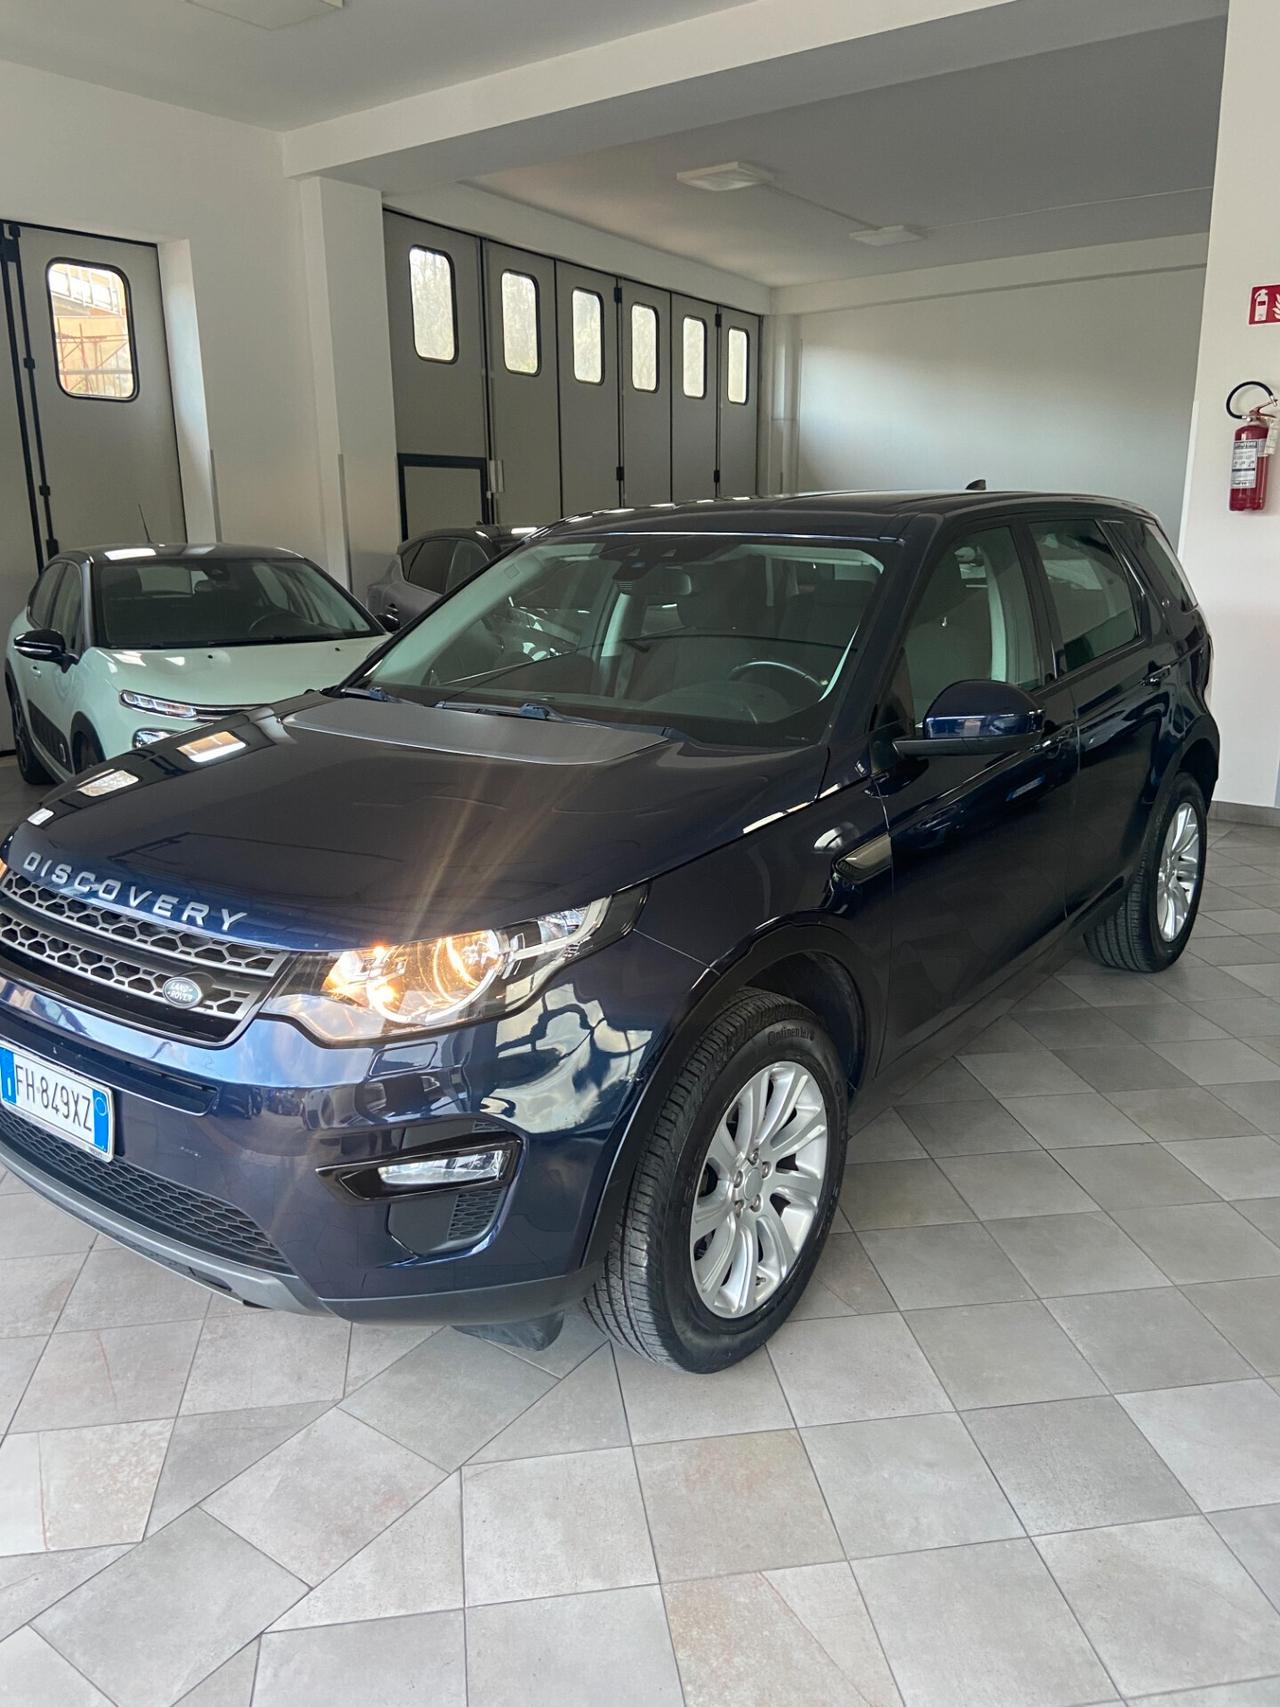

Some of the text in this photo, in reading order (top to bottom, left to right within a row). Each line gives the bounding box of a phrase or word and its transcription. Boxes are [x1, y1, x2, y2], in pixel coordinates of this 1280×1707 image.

[23, 852, 247, 931] DISCOVERY
[170, 982, 189, 993] LAND
[170, 990, 193, 1002] ROVER
